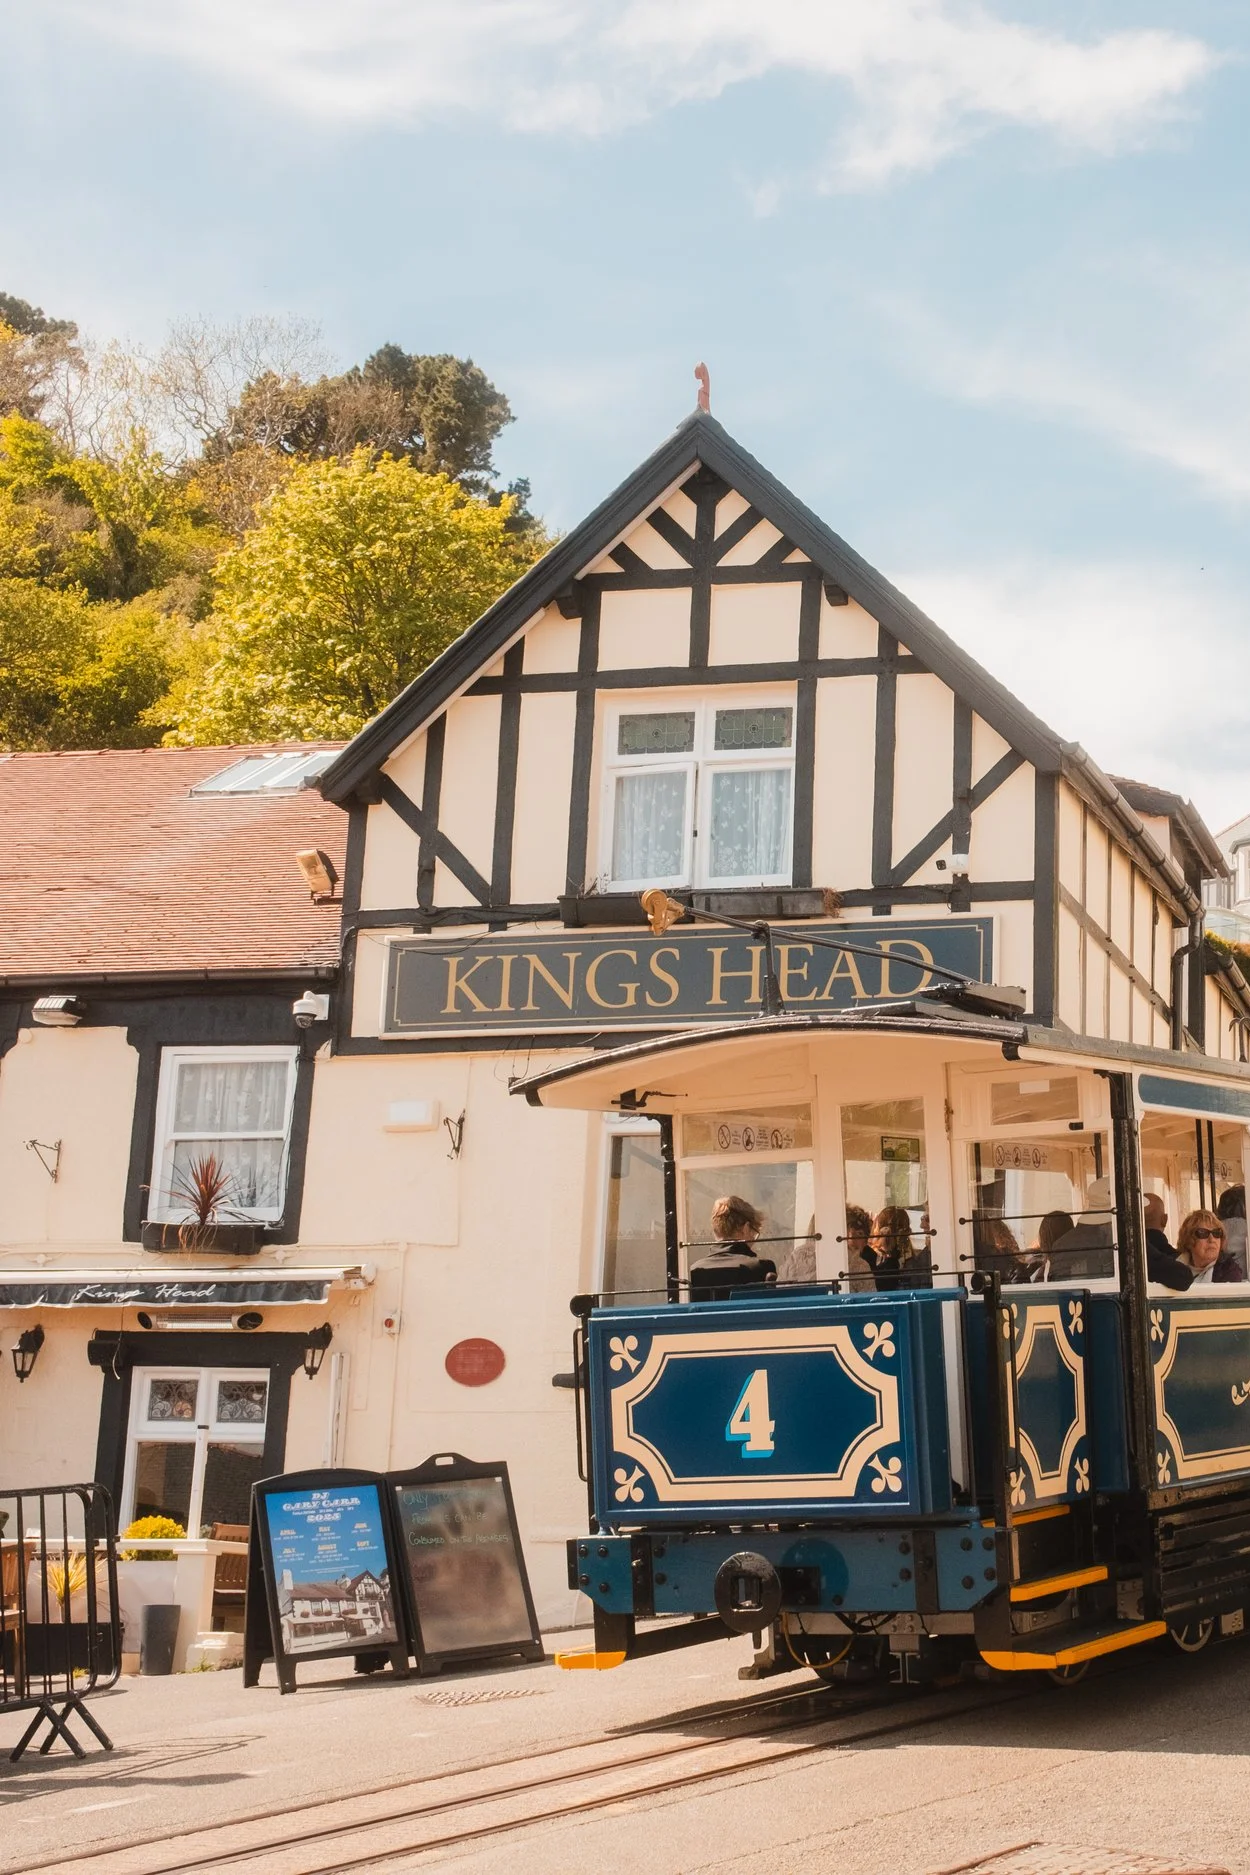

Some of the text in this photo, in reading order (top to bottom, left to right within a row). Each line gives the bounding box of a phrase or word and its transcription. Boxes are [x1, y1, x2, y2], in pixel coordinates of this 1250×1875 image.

[440, 938, 934, 1014] KINGS HEAD
[73, 1283, 217, 1303] Kings Head
[726, 1369, 775, 1458] 4
[312, 1492, 329, 1500] DJ
